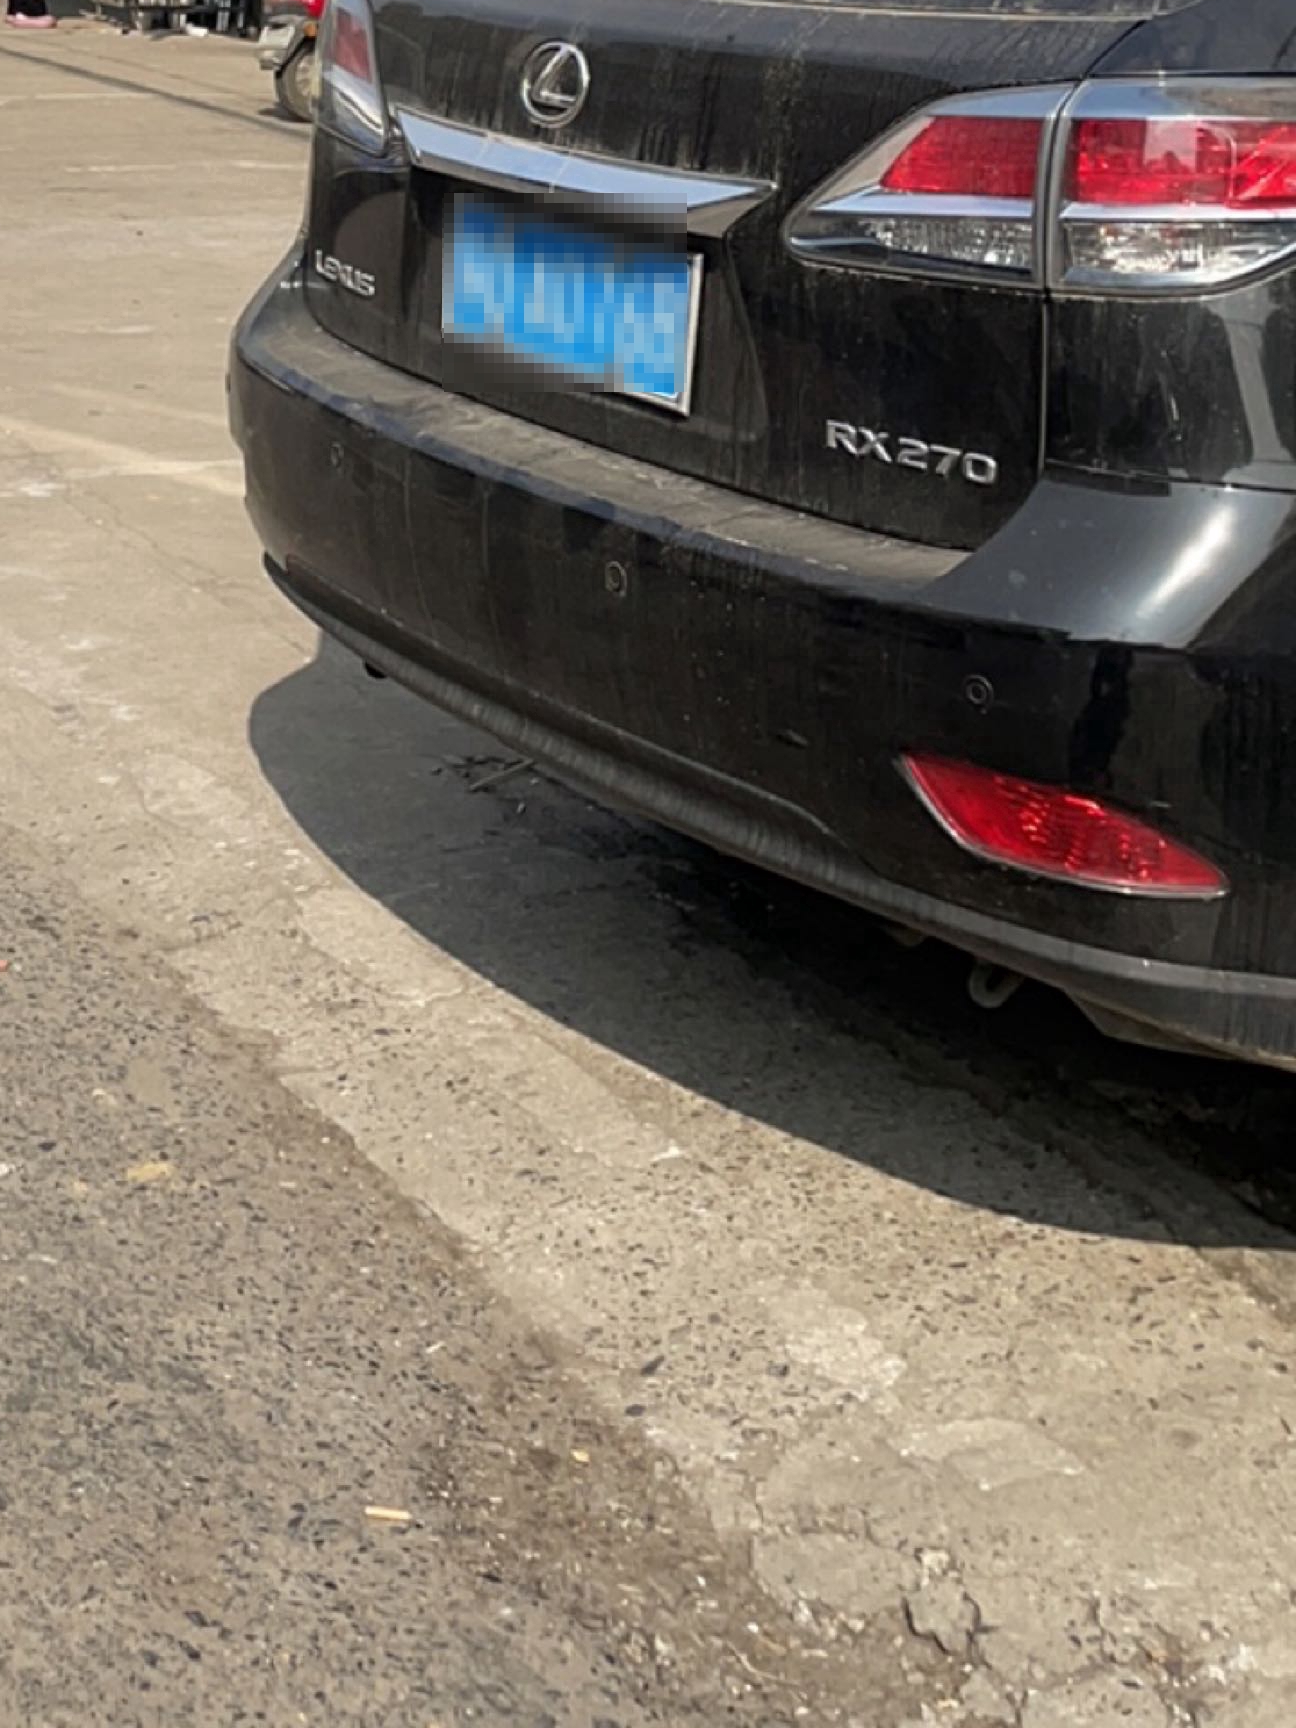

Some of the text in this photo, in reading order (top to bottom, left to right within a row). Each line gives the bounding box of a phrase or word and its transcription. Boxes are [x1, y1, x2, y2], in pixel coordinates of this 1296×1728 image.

[314, 248, 376, 297] LEXUS
[825, 418, 998, 485] RX 270
